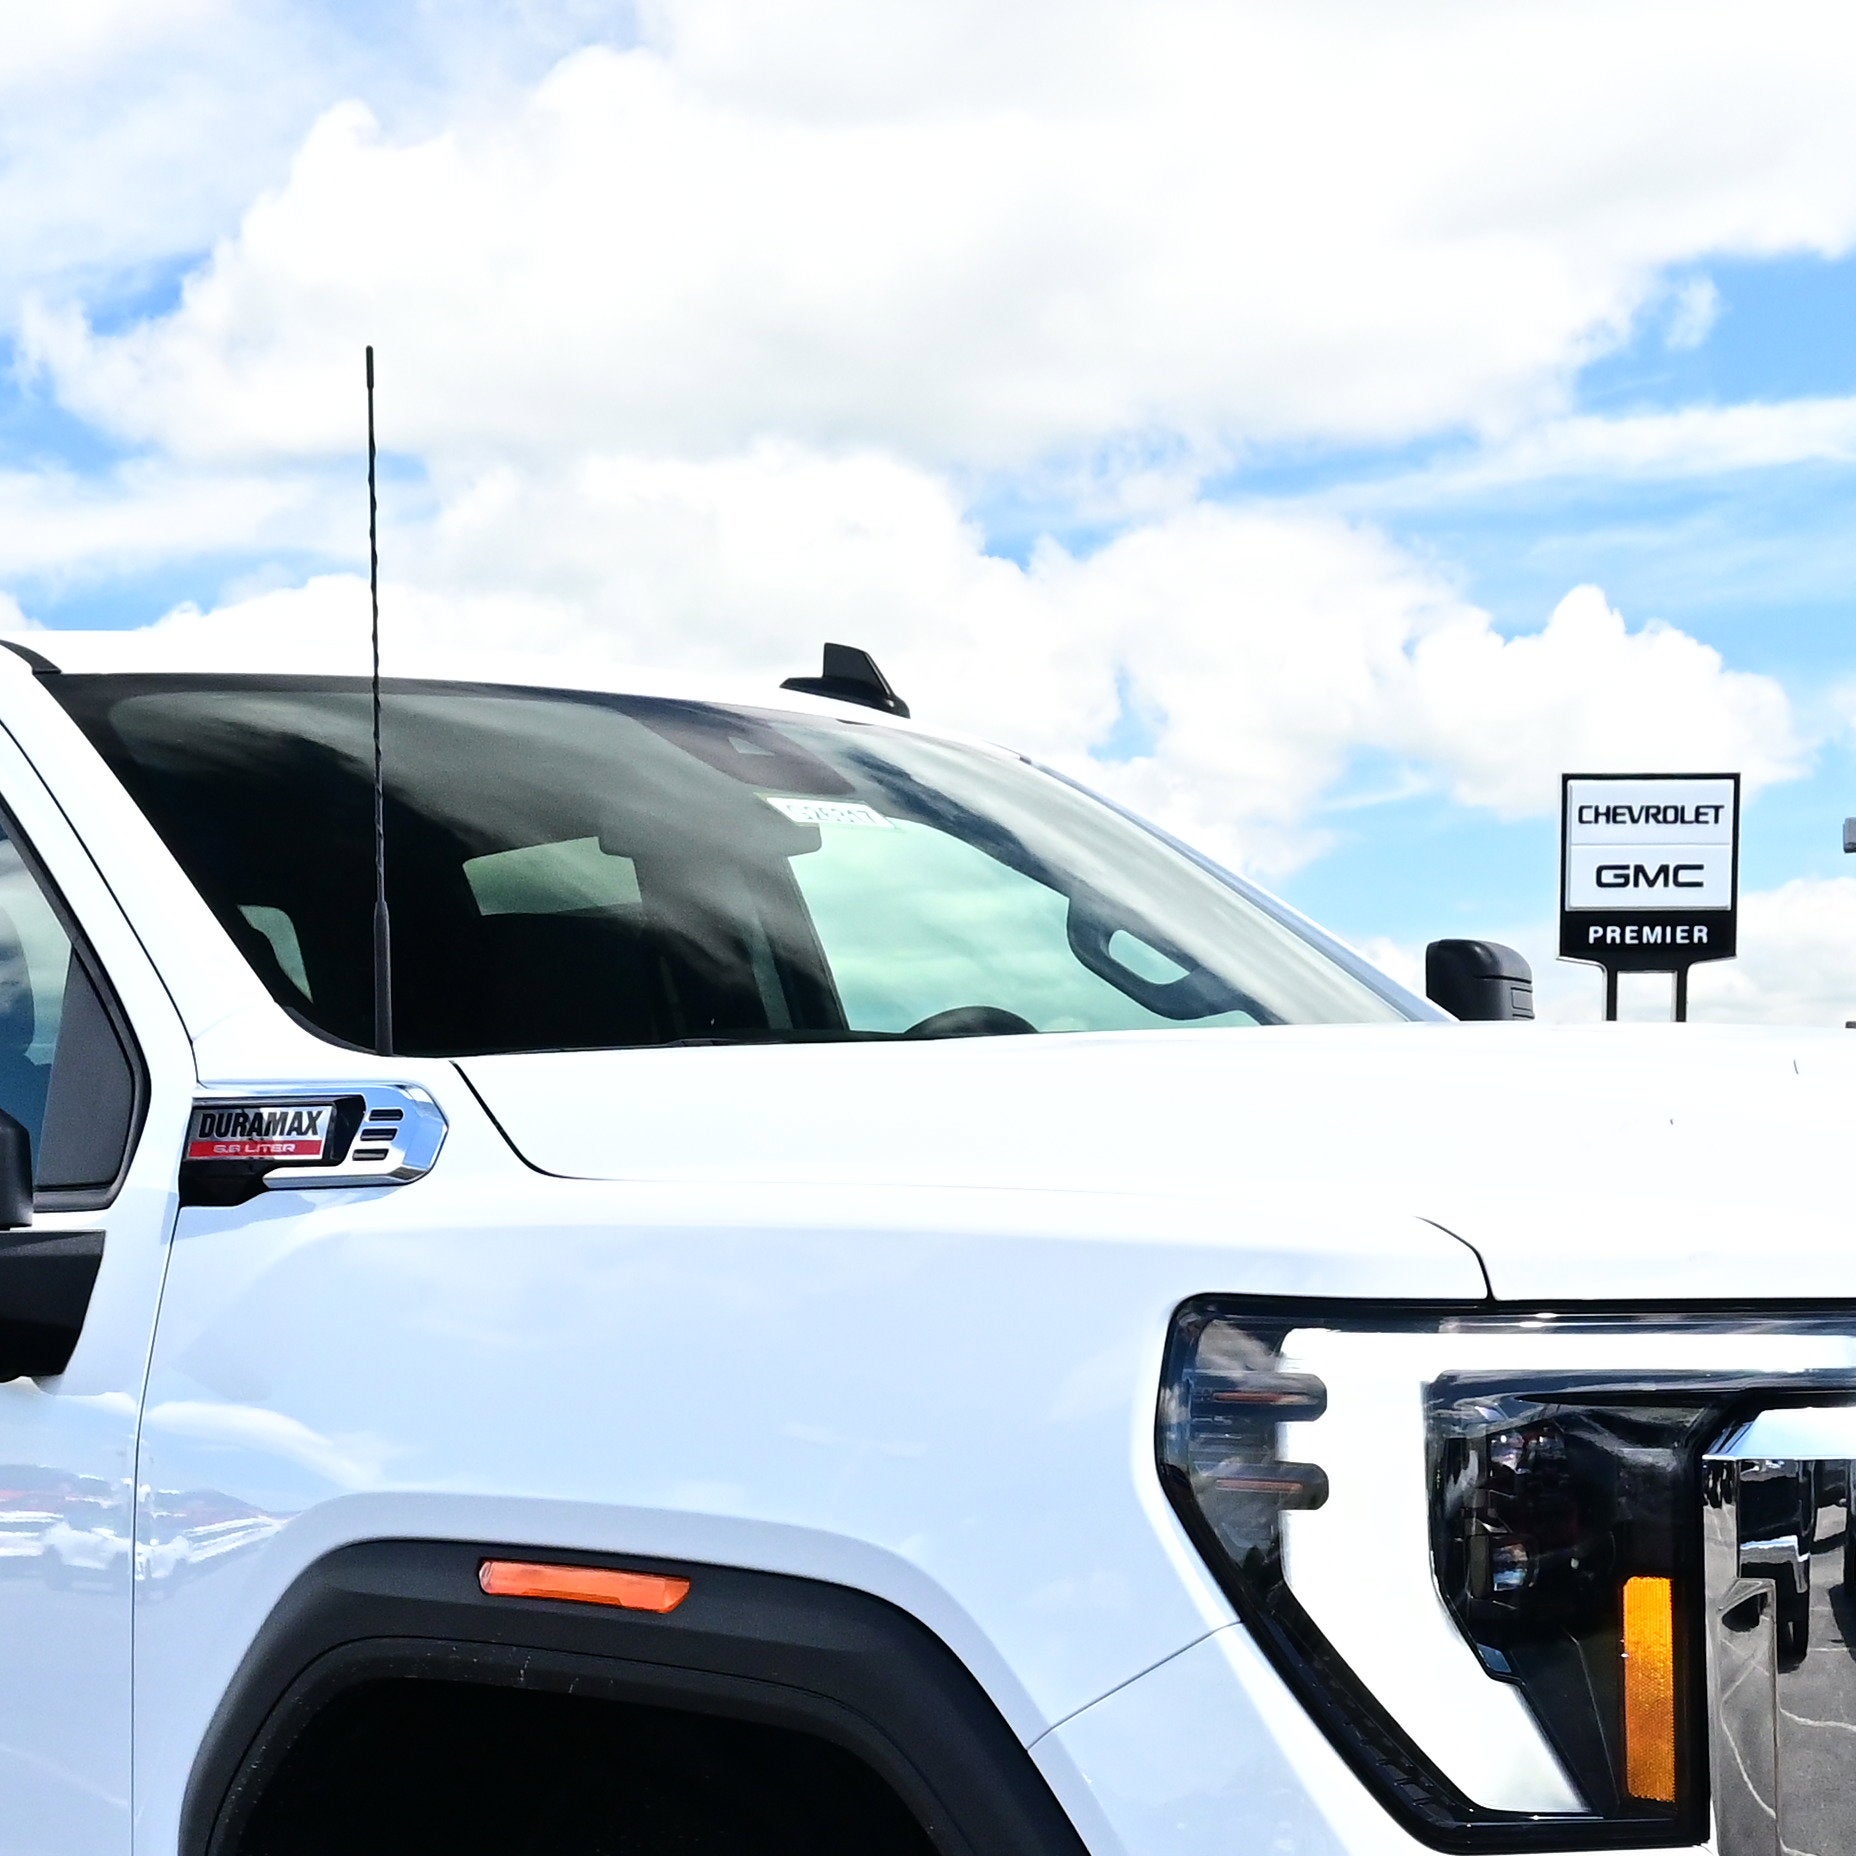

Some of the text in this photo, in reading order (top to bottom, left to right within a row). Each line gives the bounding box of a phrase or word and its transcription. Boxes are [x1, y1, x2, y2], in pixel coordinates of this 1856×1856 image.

[1577, 804, 1726, 825] CHEVROLET
[1595, 863, 1705, 889] GMC
[1587, 925, 1710, 945] PREMIER
[198, 1110, 324, 1139] DURAMAX
[244, 1143, 296, 1153] LITER
